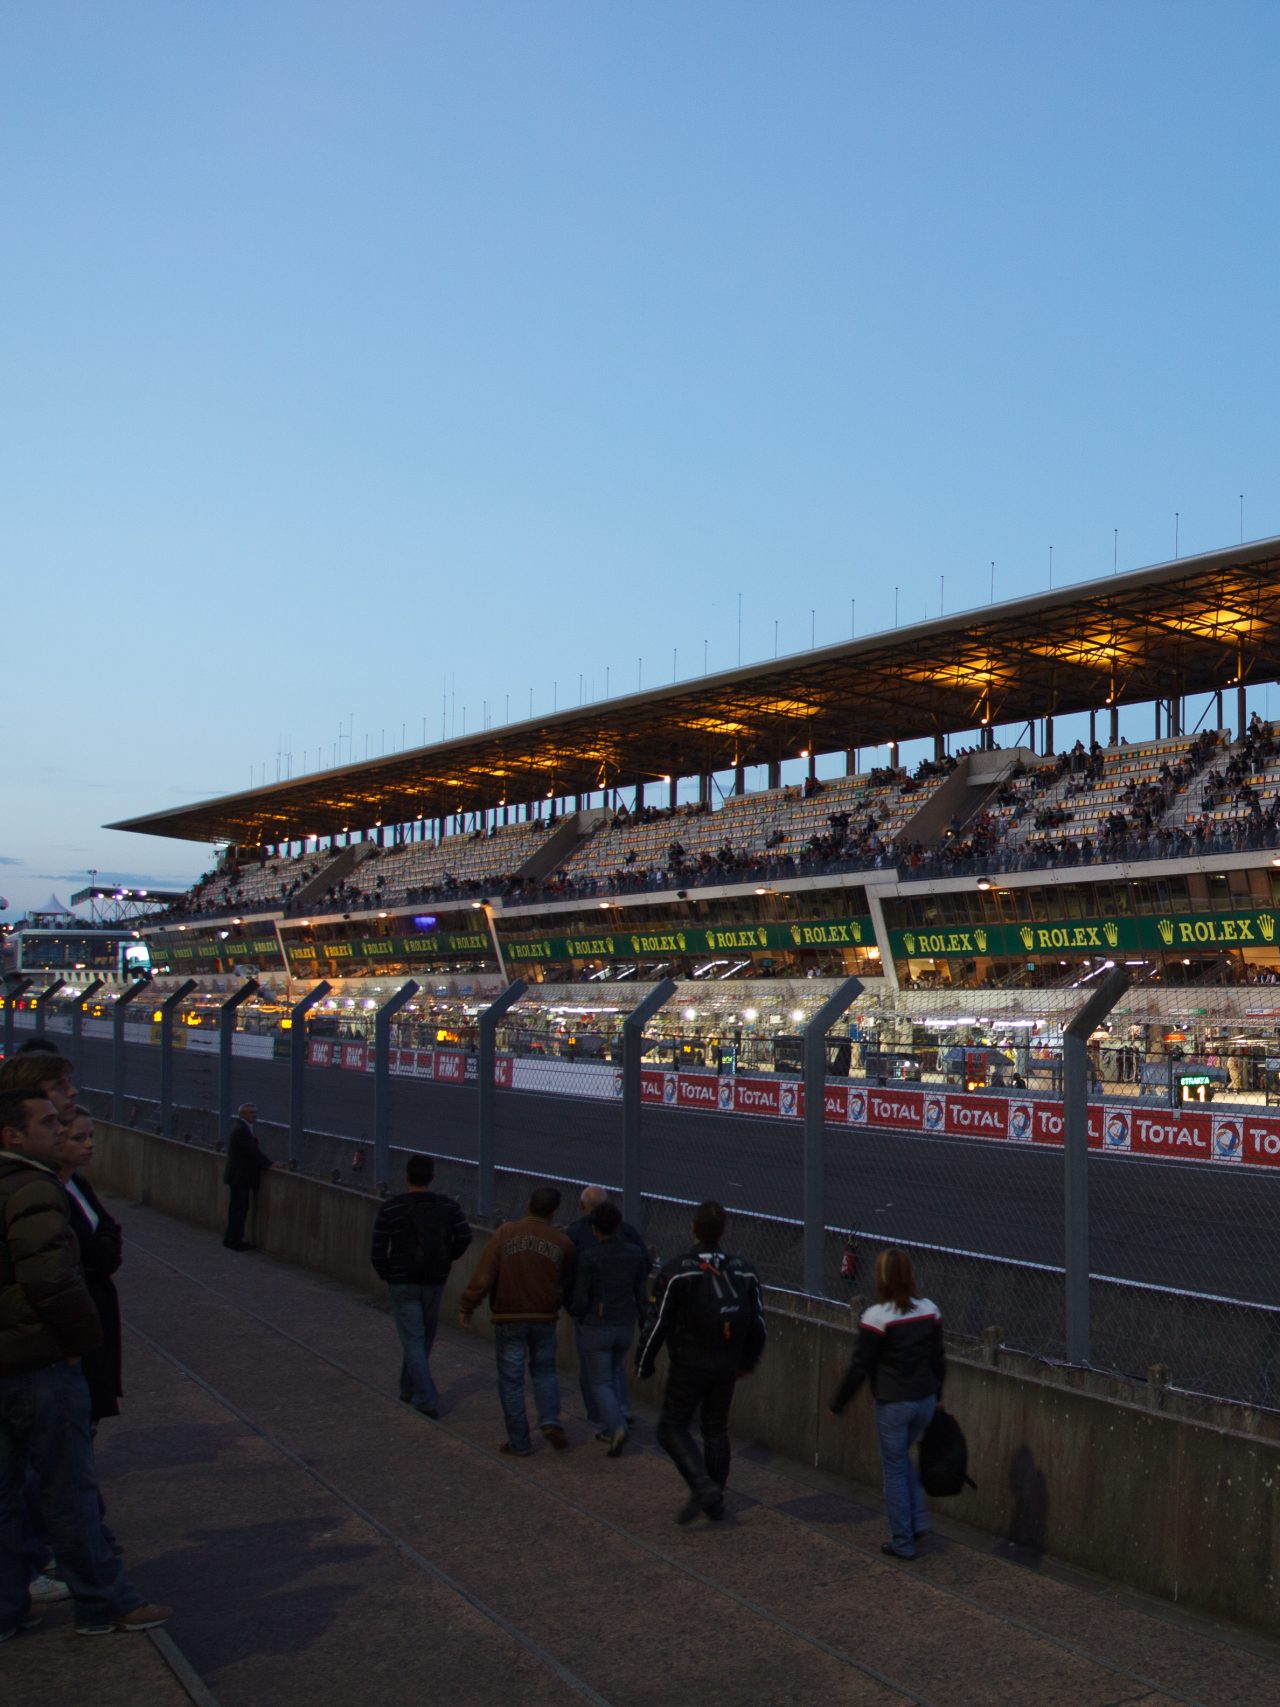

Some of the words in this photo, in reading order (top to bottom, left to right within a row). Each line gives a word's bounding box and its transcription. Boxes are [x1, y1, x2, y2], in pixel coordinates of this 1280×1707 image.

[718, 930, 757, 948] ROLEX
[803, 925, 849, 944] ROLEX
[1037, 922, 1102, 948] ROLEX
[1178, 918, 1254, 943] ROLEX
[329, 945, 348, 957] ROLEX
[367, 942, 388, 954] ROLEX
[410, 940, 433, 952] ROLEX
[456, 936, 481, 949] ROLEX
[515, 943, 543, 958] ROLEX
[575, 940, 607, 954] ROLEX
[641, 936, 677, 952] ROLEX
[919, 933, 973, 953] ROLEX
[294, 947, 312, 959] ROLEX
[641, 1081, 661, 1096] TAL
[680, 1082, 716, 1101] TOTAL
[738, 1087, 777, 1107] TOTAL
[871, 1097, 920, 1121] TOTAL
[949, 1105, 1004, 1129] TOTAL
[1038, 1111, 1099, 1138] TOL
[1136, 1120, 1207, 1148] TOTAL
